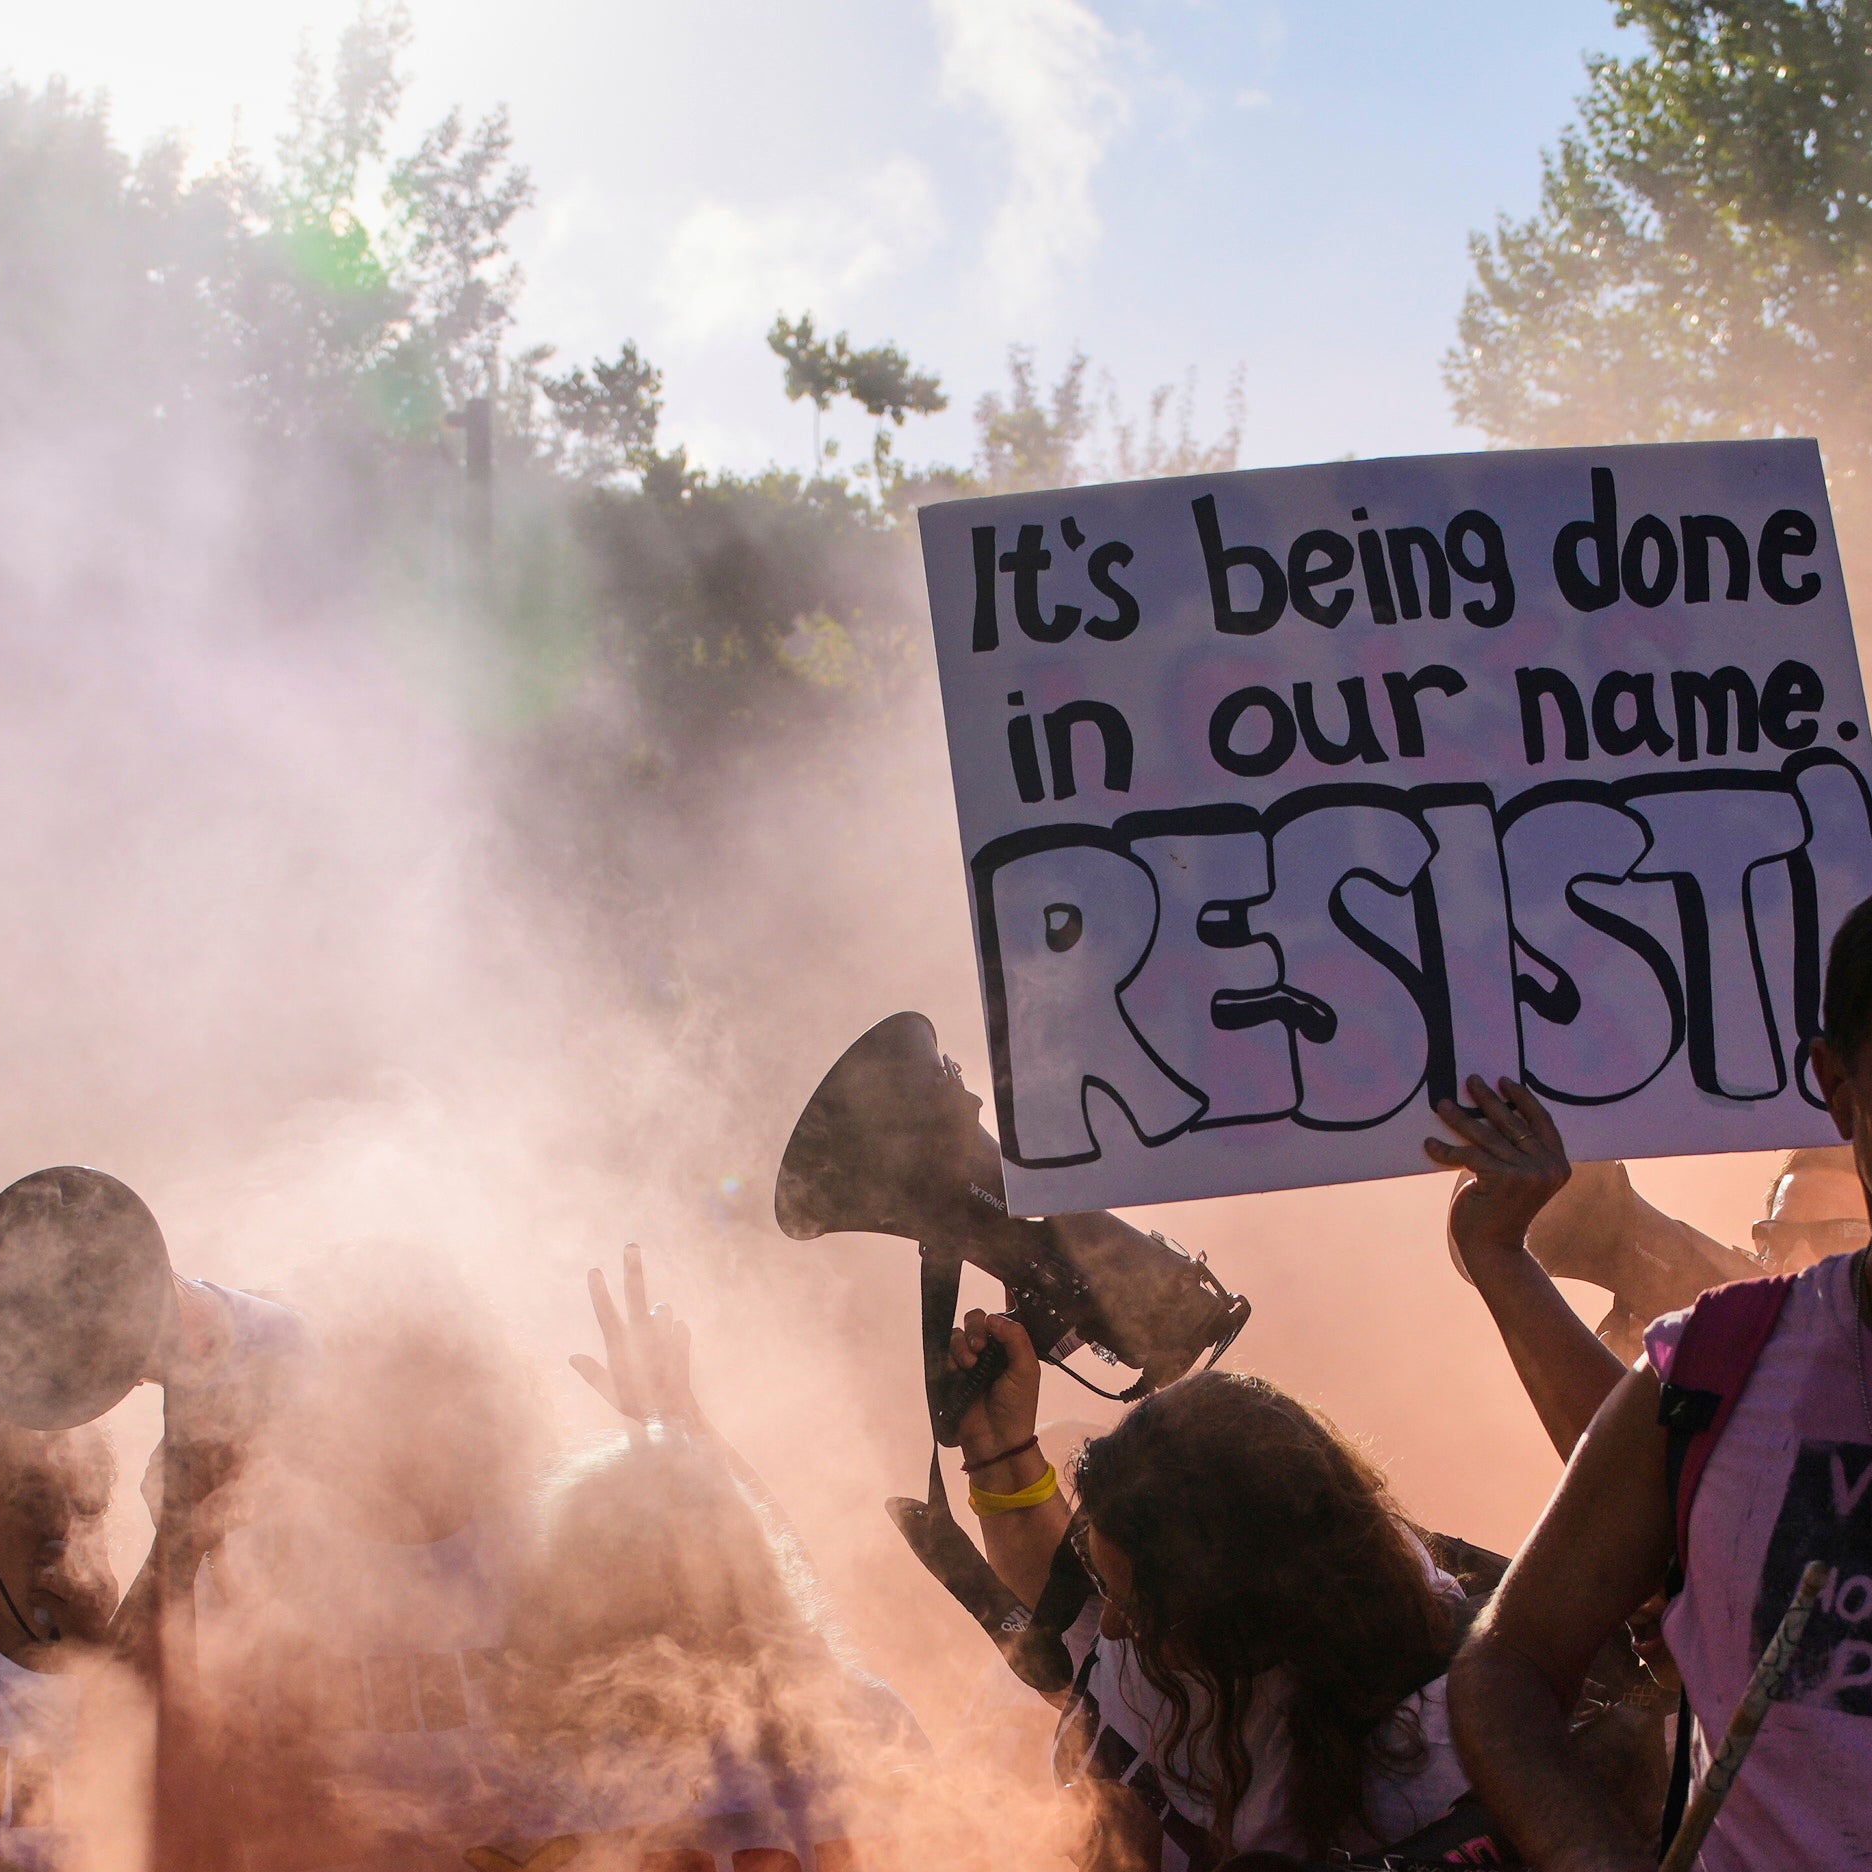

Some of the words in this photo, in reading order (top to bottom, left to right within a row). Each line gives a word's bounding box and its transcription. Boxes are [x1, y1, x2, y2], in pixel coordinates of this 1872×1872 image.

[971, 516, 1140, 653] It's
[1191, 493, 1516, 637] being
[1552, 466, 1822, 614] done
[1006, 691, 1134, 803] in
[1209, 664, 1468, 777] our
[1516, 659, 1860, 764] name.
